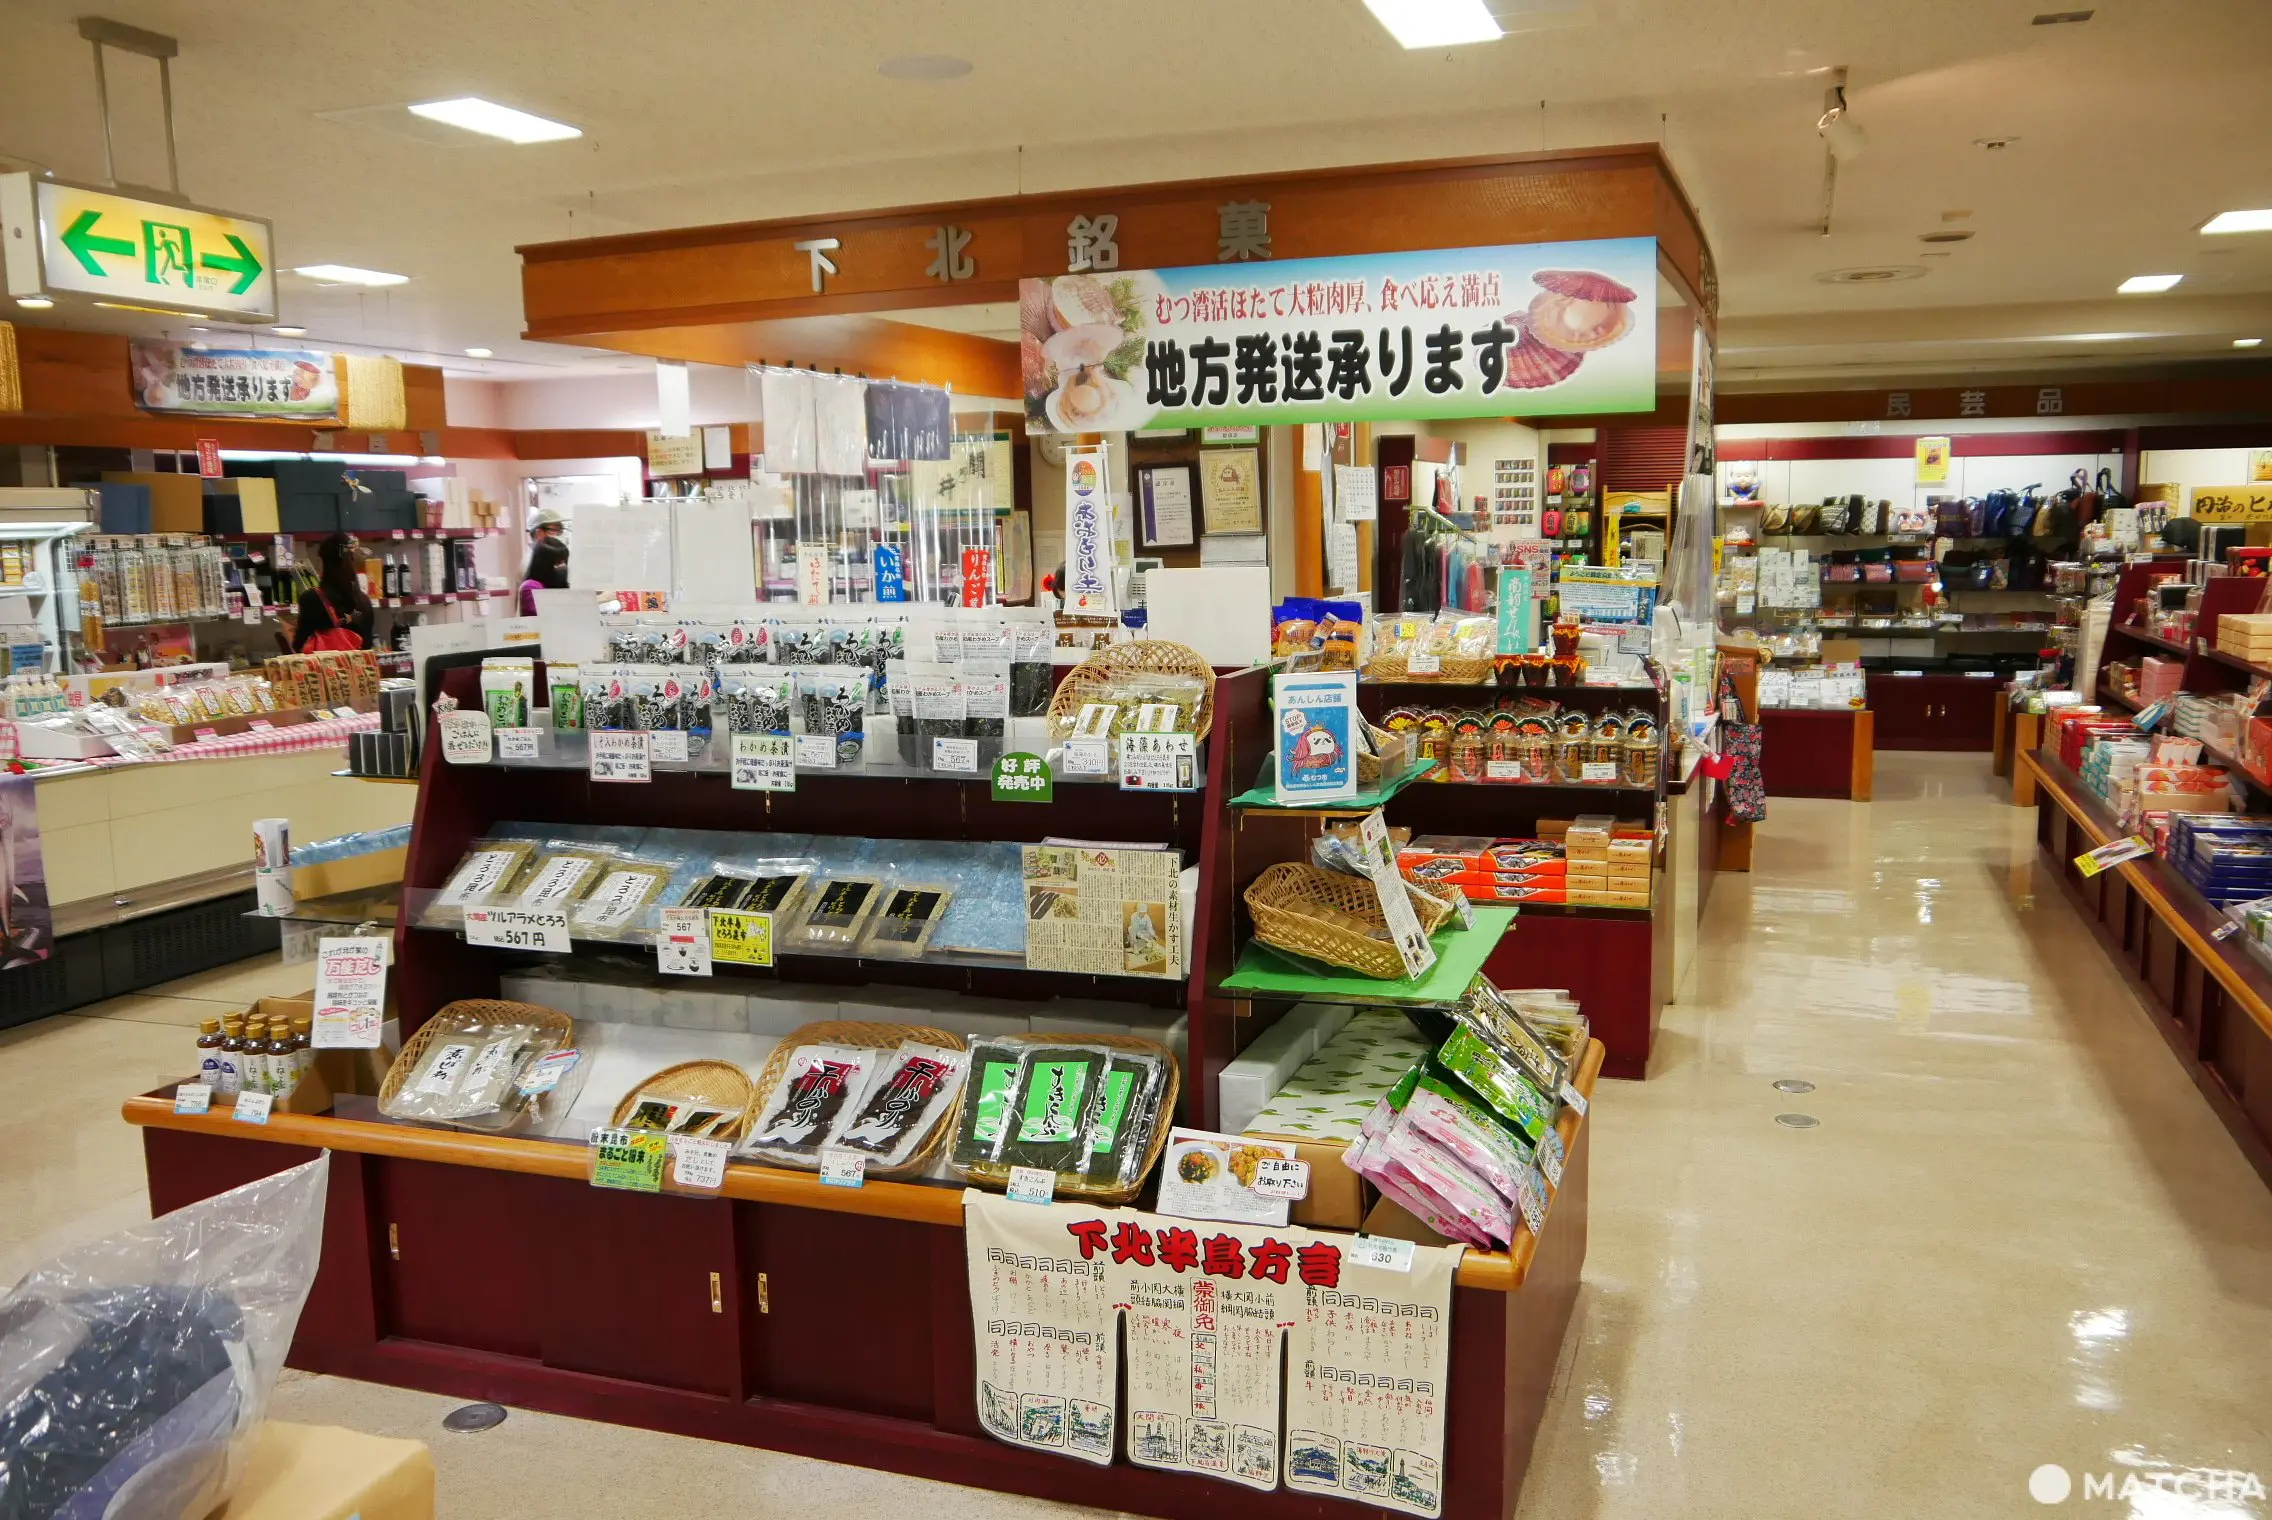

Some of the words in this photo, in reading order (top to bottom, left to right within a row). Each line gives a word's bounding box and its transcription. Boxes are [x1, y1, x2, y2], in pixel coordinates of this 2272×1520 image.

[795, 200, 1272, 293] 下北銘菓
[1155, 272, 1501, 325] むつ湾活ほたて大粒肉厚、食べ応え満点
[1146, 320, 1519, 407] 地方発送承ります
[176, 373, 292, 402] 地方発送承ります
[1887, 388, 2063, 417] 民芸品
[1516, 545, 1539, 554] SNS
[1288, 693, 1342, 705] あんしん店舗
[740, 741, 790, 755] わかめ茶漬
[1126, 736, 1189, 753] 海藻あわせ
[997, 774, 1046, 790] 発売中
[1168, 857, 1180, 966] 下北の素材生かす工夫
[676, 923, 691, 931] 567
[713, 916, 742, 929] 下北半島
[716, 928, 747, 942] とろろ昆布
[326, 957, 382, 977] 万能だし
[591, 1132, 629, 1146] 粉末昆布
[598, 1146, 646, 1164] まるごと粉末
[840, 1169, 857, 1177] 567
[1261, 1161, 1300, 1172] ご自由に
[1257, 1176, 1304, 1189] お取り下さい
[1028, 1187, 1045, 1198] 510
[1067, 1219, 1342, 1288] 下北半島方言
[1193, 1280, 1215, 1331] 蒙御免
[1325, 1309, 1337, 1328] 子供
[1172, 1328, 1186, 1339] 夜
[1026, 1340, 1035, 1358] おやつ
[1305, 1380, 1313, 1391] 牛
